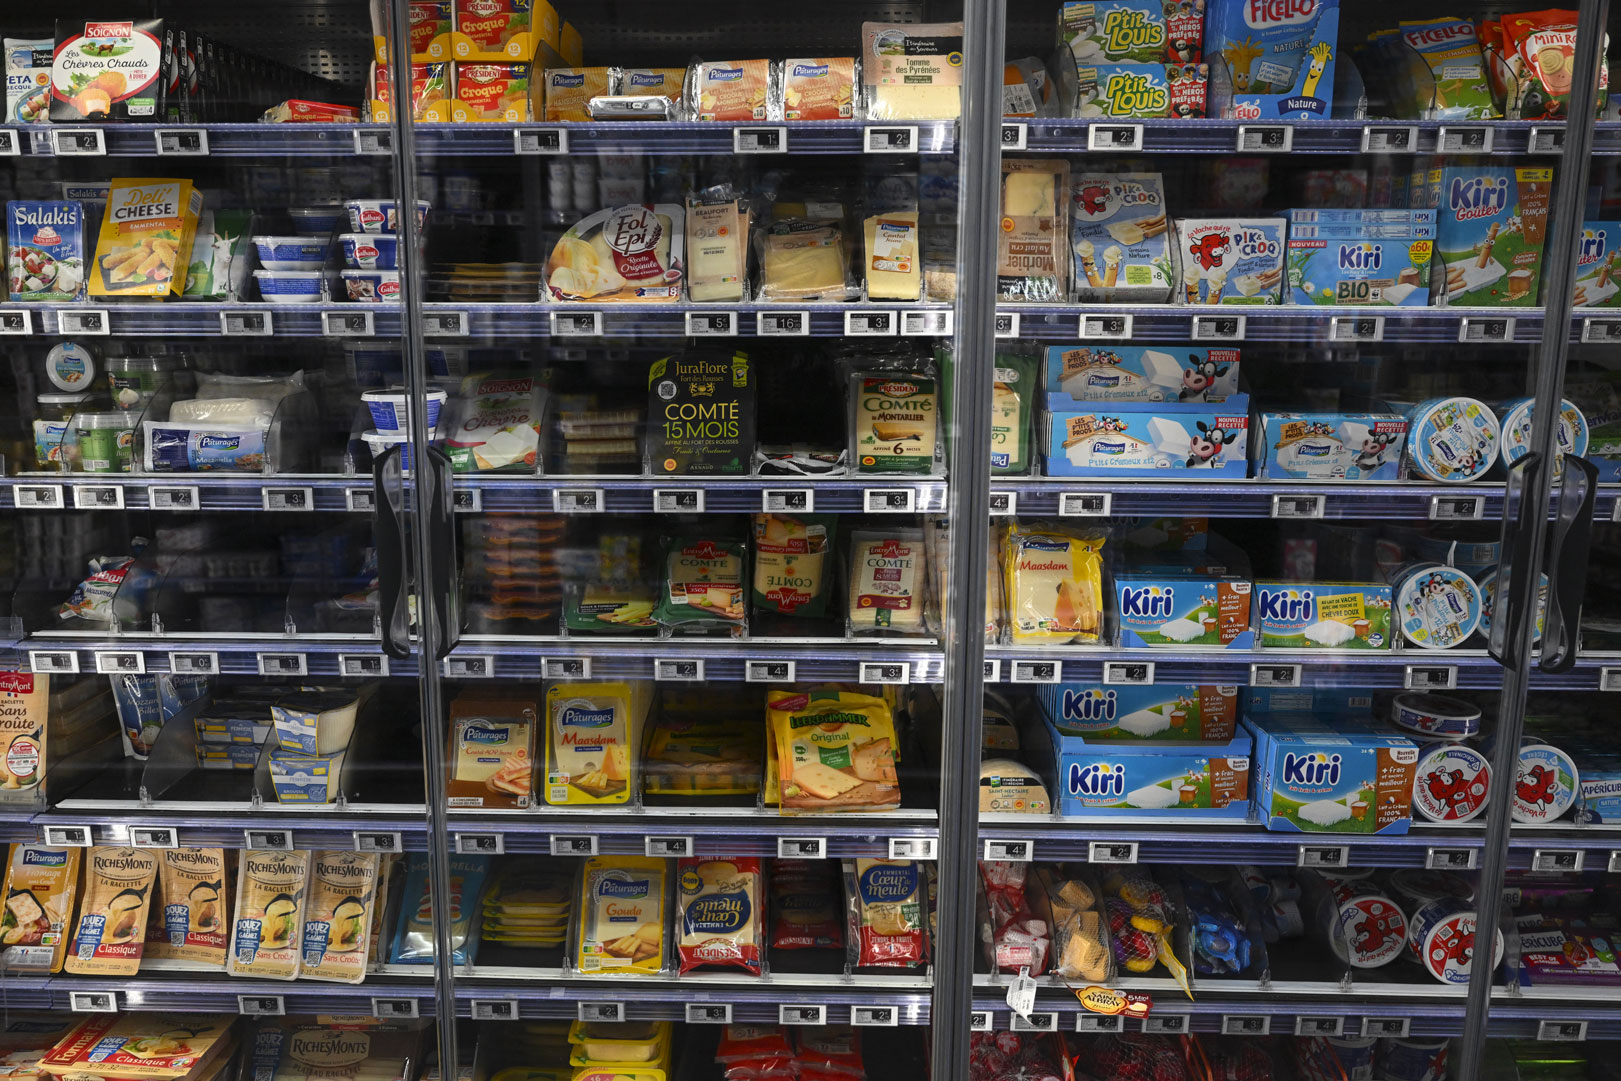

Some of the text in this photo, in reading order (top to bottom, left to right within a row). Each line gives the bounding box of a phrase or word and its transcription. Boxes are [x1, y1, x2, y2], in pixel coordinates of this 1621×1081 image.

[467, 2, 502, 11] PRÉSIDENT
[1250, 0, 1314, 22] FICELLO
[462, 19, 504, 32] Croque
[1105, 9, 1146, 35] P'tit
[87, 27, 131, 37] SOIGNON
[1110, 24, 1163, 50] Louis
[1407, 26, 1473, 46] FICELLO
[1534, 31, 1563, 44] Mini
[1274, 39, 1305, 53] NATURE
[65, 49, 80, 59] Les
[62, 59, 104, 70] Chèvres
[106, 58, 149, 68] Chauds
[906, 59, 931, 67] Tomme
[466, 69, 501, 78] PRÉSIDENT
[710, 68, 743, 80] Pâturages
[795, 66, 829, 77] Pâturages
[896, 66, 940, 75] des Pyrénées
[460, 85, 503, 98] Croque
[1108, 73, 1148, 98] P'tit
[1112, 87, 1166, 115] Louis
[1287, 99, 1317, 109] Nature
[70, 190, 97, 198] Salakis
[124, 188, 171, 206] Deli'
[1123, 193, 1155, 203] CROQ
[1451, 177, 1508, 210] Kiri
[16, 206, 77, 225] Salakis
[114, 203, 172, 219] CHEESE
[695, 207, 729, 217] BEAUFORT
[1456, 204, 1500, 222] Goûter
[1522, 207, 1546, 216] FRANÇAIS
[360, 213, 382, 222] Galbani
[617, 210, 648, 231] Fol
[130, 221, 166, 229] EMMENTAL
[1194, 225, 1231, 235] Vache qui rit
[883, 231, 906, 239] Cantal
[614, 229, 647, 256] Epi
[1040, 243, 1050, 252] Au
[1243, 240, 1277, 256] CROQ
[356, 249, 376, 257] Galbani
[1338, 244, 1381, 269] Kiri
[620, 261, 658, 273] Originale
[1005, 255, 1054, 271] Morbier
[1337, 281, 1368, 299] BIO
[675, 361, 728, 376] JuraFlore
[1068, 361, 1087, 370] PRODS
[1089, 375, 1119, 385] Pâturages
[479, 382, 530, 394] SOIGNON
[879, 384, 919, 393] PRÉSIDENT
[1136, 389, 1148, 397] x12
[665, 400, 739, 420] COMTÉ
[864, 396, 932, 412] COMTÉ
[464, 413, 530, 431] Chèvre
[878, 413, 924, 421] MONTARLIER
[662, 421, 739, 438] 15 MOIS
[1073, 422, 1091, 430] P'TITS
[1073, 428, 1092, 436] PRODS
[203, 436, 238, 448] Pâturages
[664, 438, 682, 446] AFFINÉ
[1095, 443, 1125, 453] Pâturages
[893, 442, 904, 455] 6
[1299, 445, 1330, 455] Pâturages
[869, 545, 910, 556] EntreMont
[680, 557, 728, 568] COMTÉ
[867, 557, 912, 568] COMTÉ
[1019, 560, 1069, 571] Maasdam
[767, 575, 812, 587] COMTÉ
[1122, 586, 1173, 616] Kiri
[1260, 590, 1312, 620] Kiri
[1321, 609, 1342, 617] CHÈVRE
[1064, 690, 1117, 719] Kiri
[566, 709, 611, 724] Pâturages
[790, 713, 870, 729] LEERDAMMER
[467, 728, 507, 741] Pâturages
[561, 732, 617, 745] Maasdam
[810, 732, 850, 746] Original
[1284, 754, 1342, 785] Kiri
[1069, 763, 1125, 794] Kiri
[26, 851, 65, 863] Pâturages
[93, 856, 153, 870] RICHESMONTS
[166, 851, 219, 867] RICHESMONTS
[247, 860, 304, 875] RICHESMONTS
[316, 862, 373, 878] RICHESMONTS
[186, 873, 213, 881] RACLETTE
[869, 870, 906, 886] Cœur
[110, 880, 142, 888] RACLETTE
[602, 881, 647, 894] Pâturages
[333, 887, 363, 895] RACLETTE
[867, 883, 908, 898] meule
[166, 906, 188, 915] JOUEZ
[606, 903, 643, 916] Gouda
[695, 898, 743, 915] meule
[83, 916, 105, 926] JOUEZ
[238, 920, 260, 930] JOUEZ
[698, 911, 740, 927] Cœur
[306, 923, 329, 933] JOUEZ
[187, 932, 223, 945] Classique
[98, 943, 137, 955] Classique
[256, 951, 271, 959] Sans
[323, 953, 338, 962] Sans
[1083, 995, 1121, 1007] ALBRAY
[1091, 990, 1117, 1001] SAINT
[256, 1034, 284, 1046] JOUEZ
[293, 1039, 367, 1056] RICHESMONTS
[116, 1055, 167, 1067] Classique
